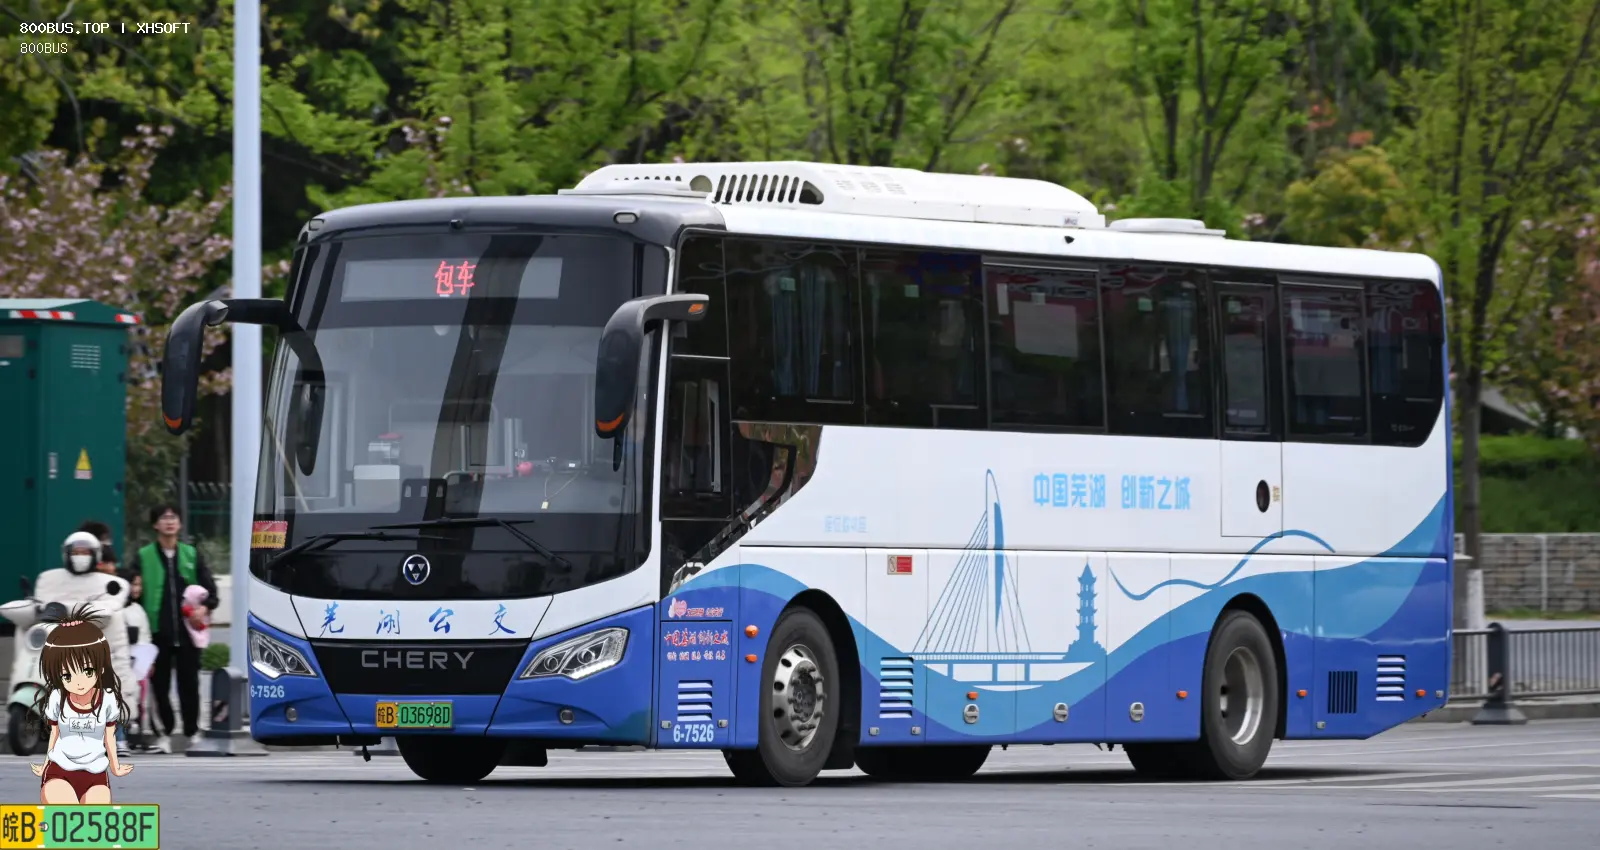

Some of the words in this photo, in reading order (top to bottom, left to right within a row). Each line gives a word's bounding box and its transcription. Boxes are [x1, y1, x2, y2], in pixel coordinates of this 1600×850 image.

[434, 260, 476, 295] 包车
[1033, 472, 1106, 508] 中国芜湖
[1121, 474, 1191, 510] 创新之城
[318, 601, 516, 638] 芜湖公交
[361, 650, 475, 669] CHERY
[250, 684, 286, 699] 6-7526
[673, 723, 715, 743] 6-7526
